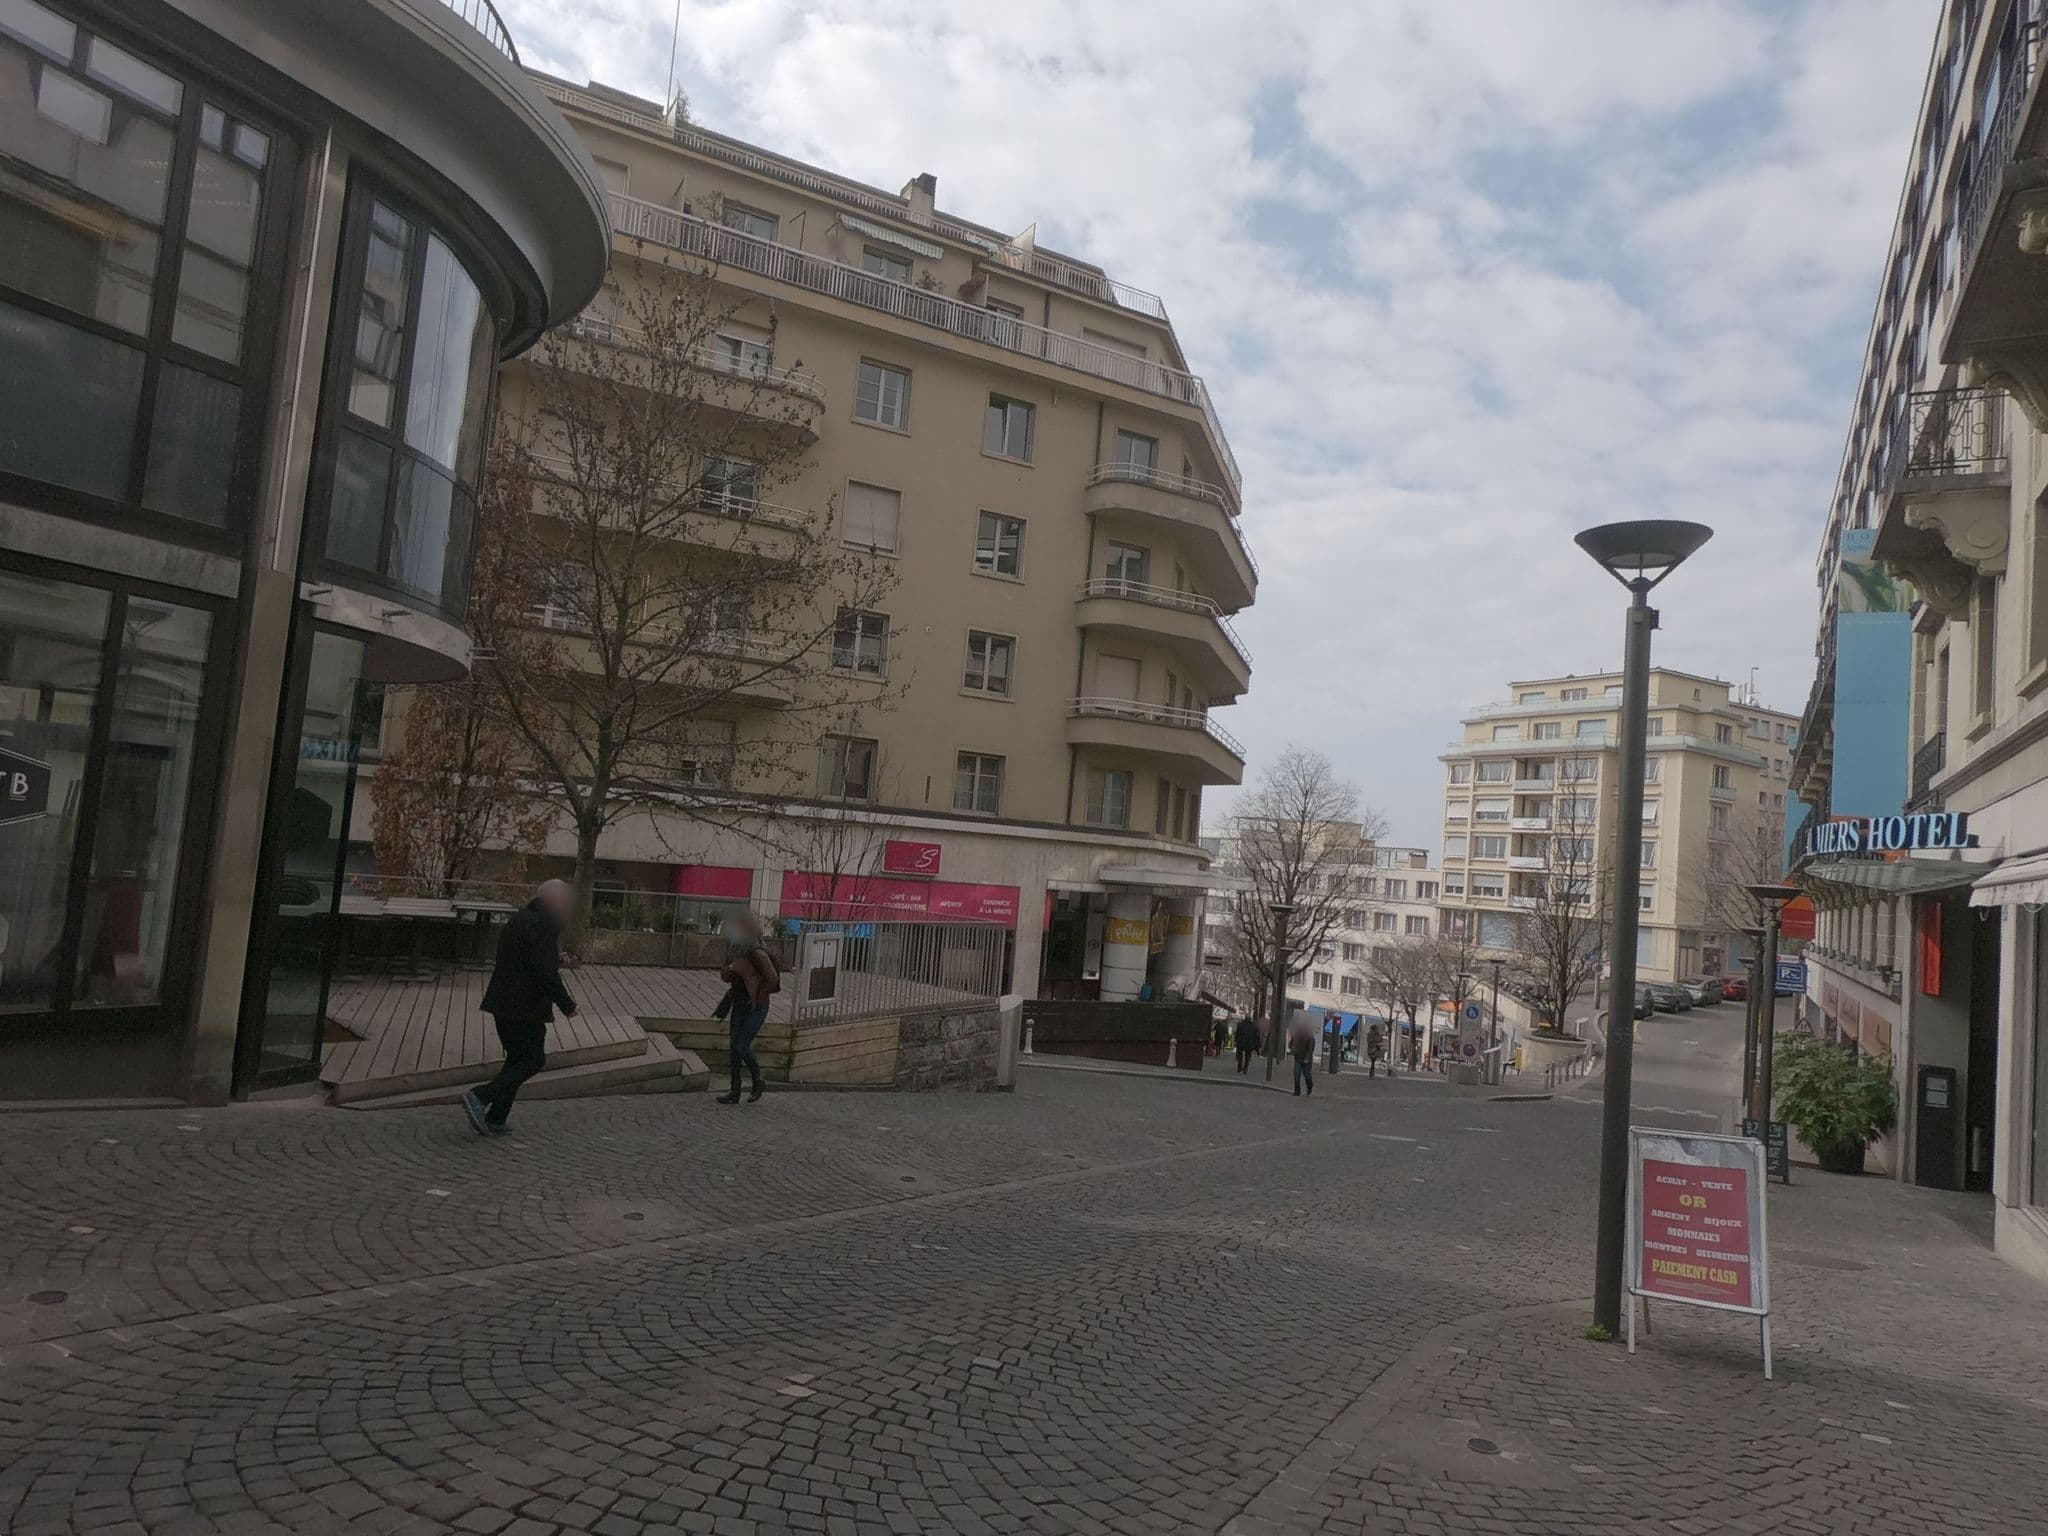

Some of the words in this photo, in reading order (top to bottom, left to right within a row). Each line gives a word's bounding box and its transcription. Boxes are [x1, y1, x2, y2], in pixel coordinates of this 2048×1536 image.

[1866, 811, 1969, 850] HOTEL
[1656, 1175, 1688, 1186] ACHAT
[1701, 1180, 1733, 1191] VENTE
[1679, 1193, 1707, 1209] OR
[1650, 1208, 1691, 1222] ARGENT
[1651, 1258, 1708, 1281] PAIEMENT
[1708, 1266, 1738, 1286] CASH
